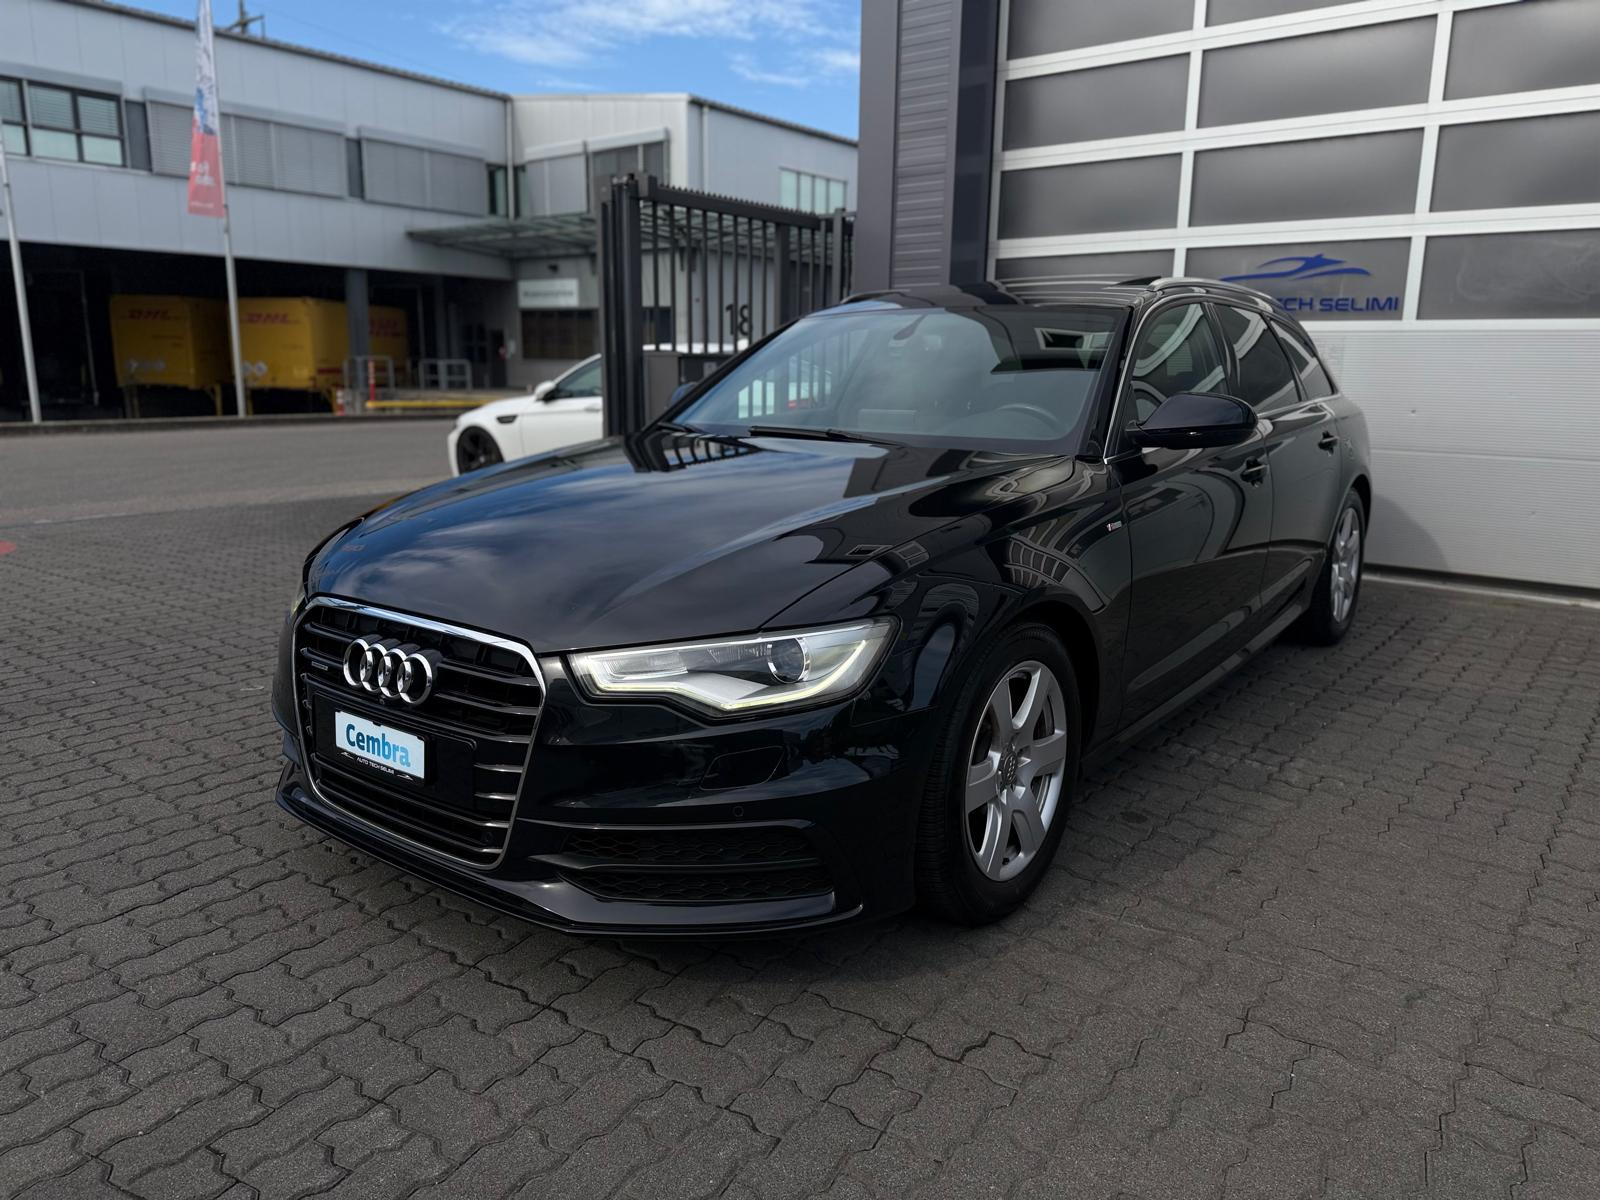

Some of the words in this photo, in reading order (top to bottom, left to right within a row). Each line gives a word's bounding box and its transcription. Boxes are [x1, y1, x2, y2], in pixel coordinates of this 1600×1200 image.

[725, 304, 753, 336] 18
[1319, 296, 1399, 312] SELIMI
[345, 723, 411, 768] Cembra
